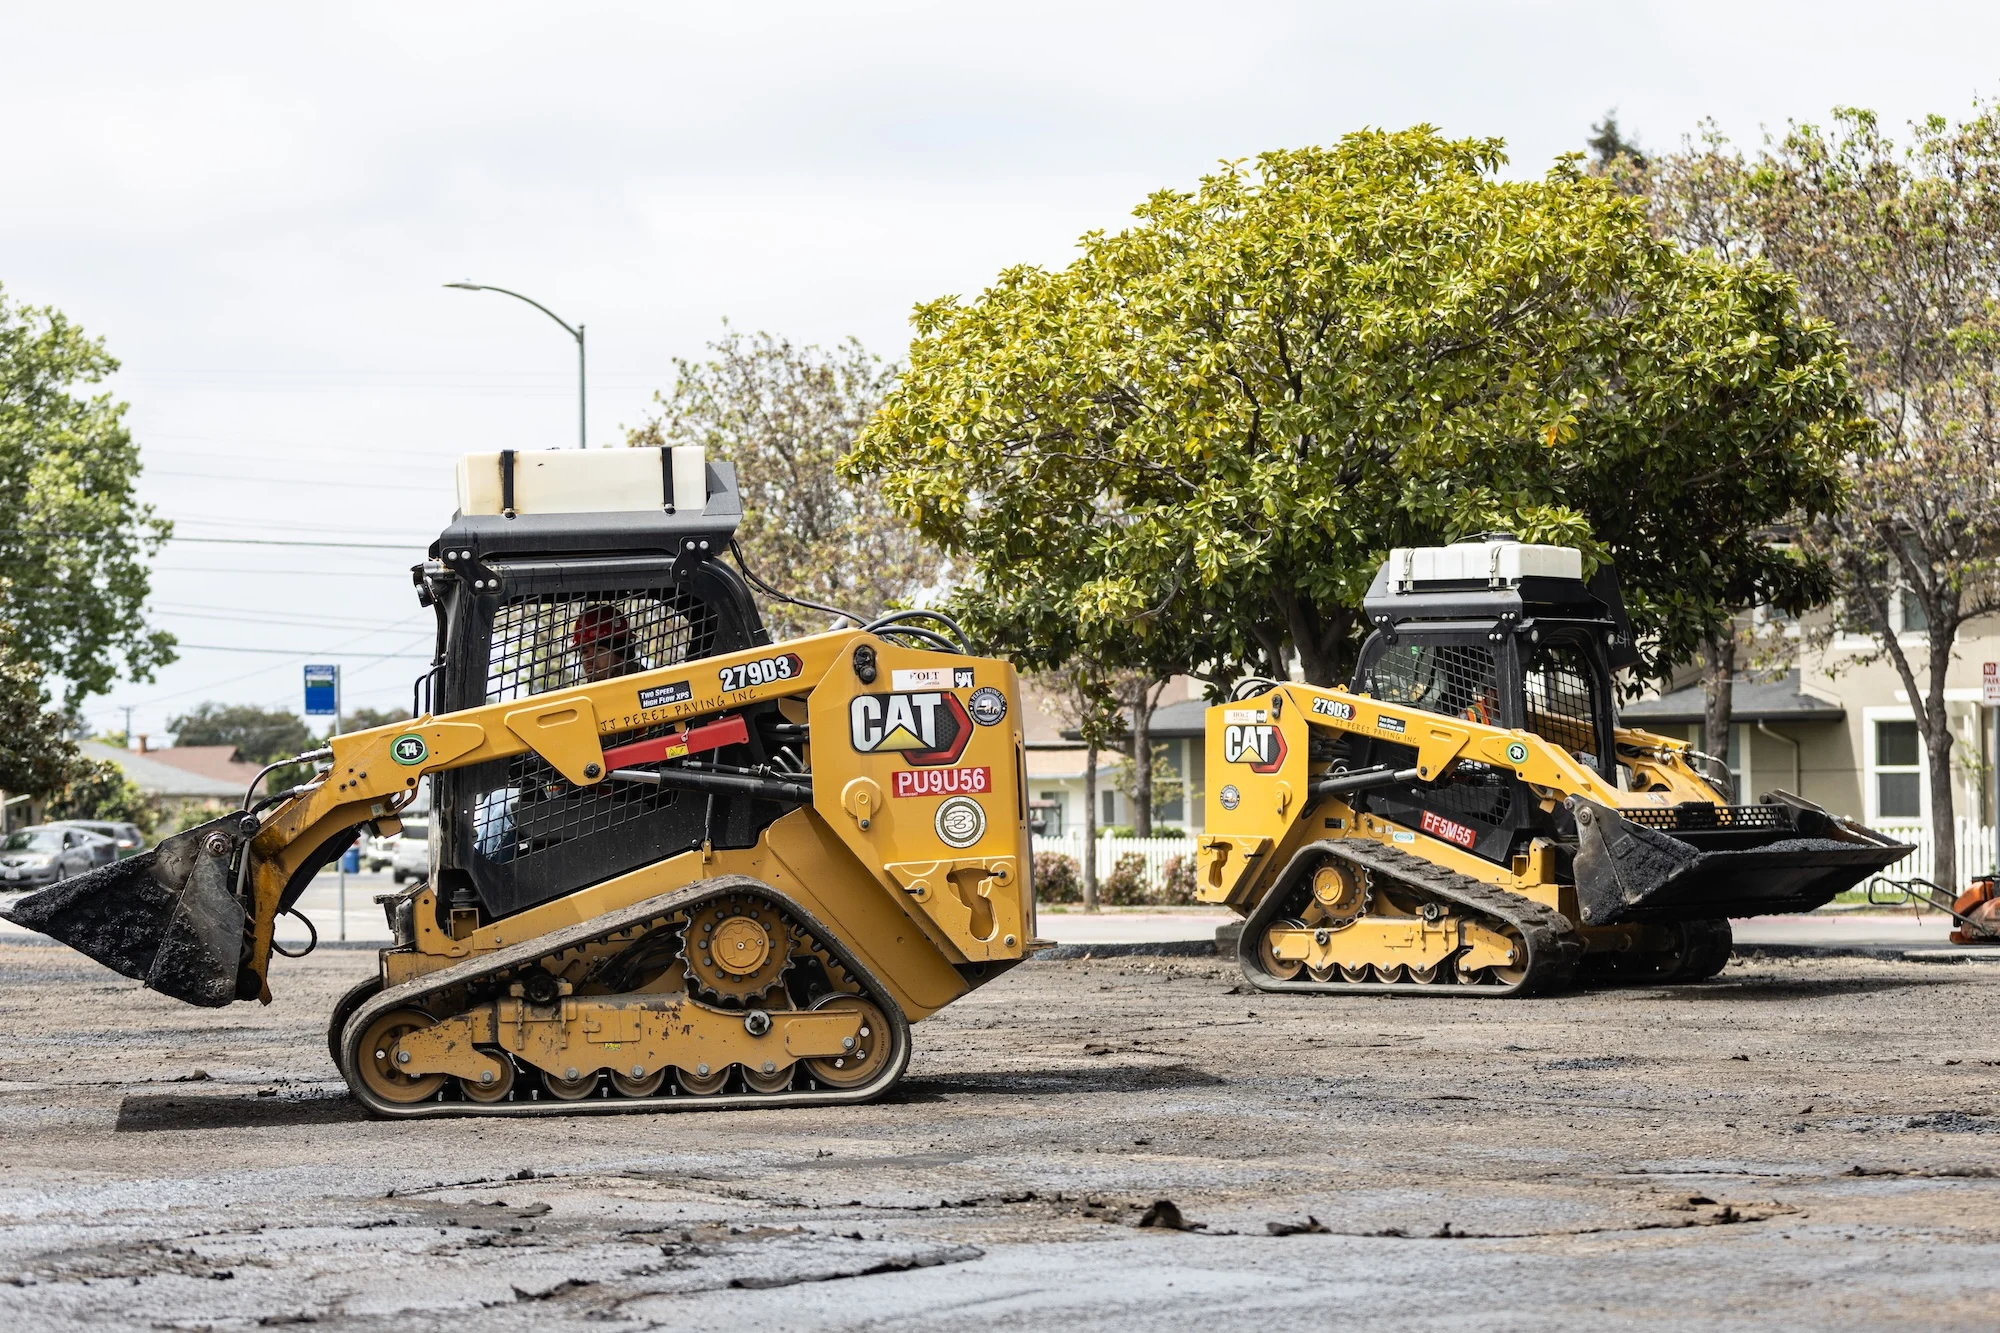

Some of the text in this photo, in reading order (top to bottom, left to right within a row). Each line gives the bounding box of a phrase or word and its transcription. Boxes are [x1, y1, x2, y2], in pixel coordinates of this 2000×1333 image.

[719, 656, 792, 692] 279D3
[641, 687, 674, 699] TWO SPEED
[643, 691, 690, 707] HIGH FLOW XPS
[601, 719, 617, 732] JJ
[624, 709, 668, 727] PEREZ
[675, 696, 725, 716] PAVING
[1312, 697, 1351, 719] 279D3
[851, 693, 941, 751] CAT
[1347, 721, 1370, 734] PEREZ
[1374, 728, 1401, 740] PAVING
[402, 742, 418, 757] T4
[1225, 726, 1273, 763] CAT
[898, 768, 986, 794] PU9U56
